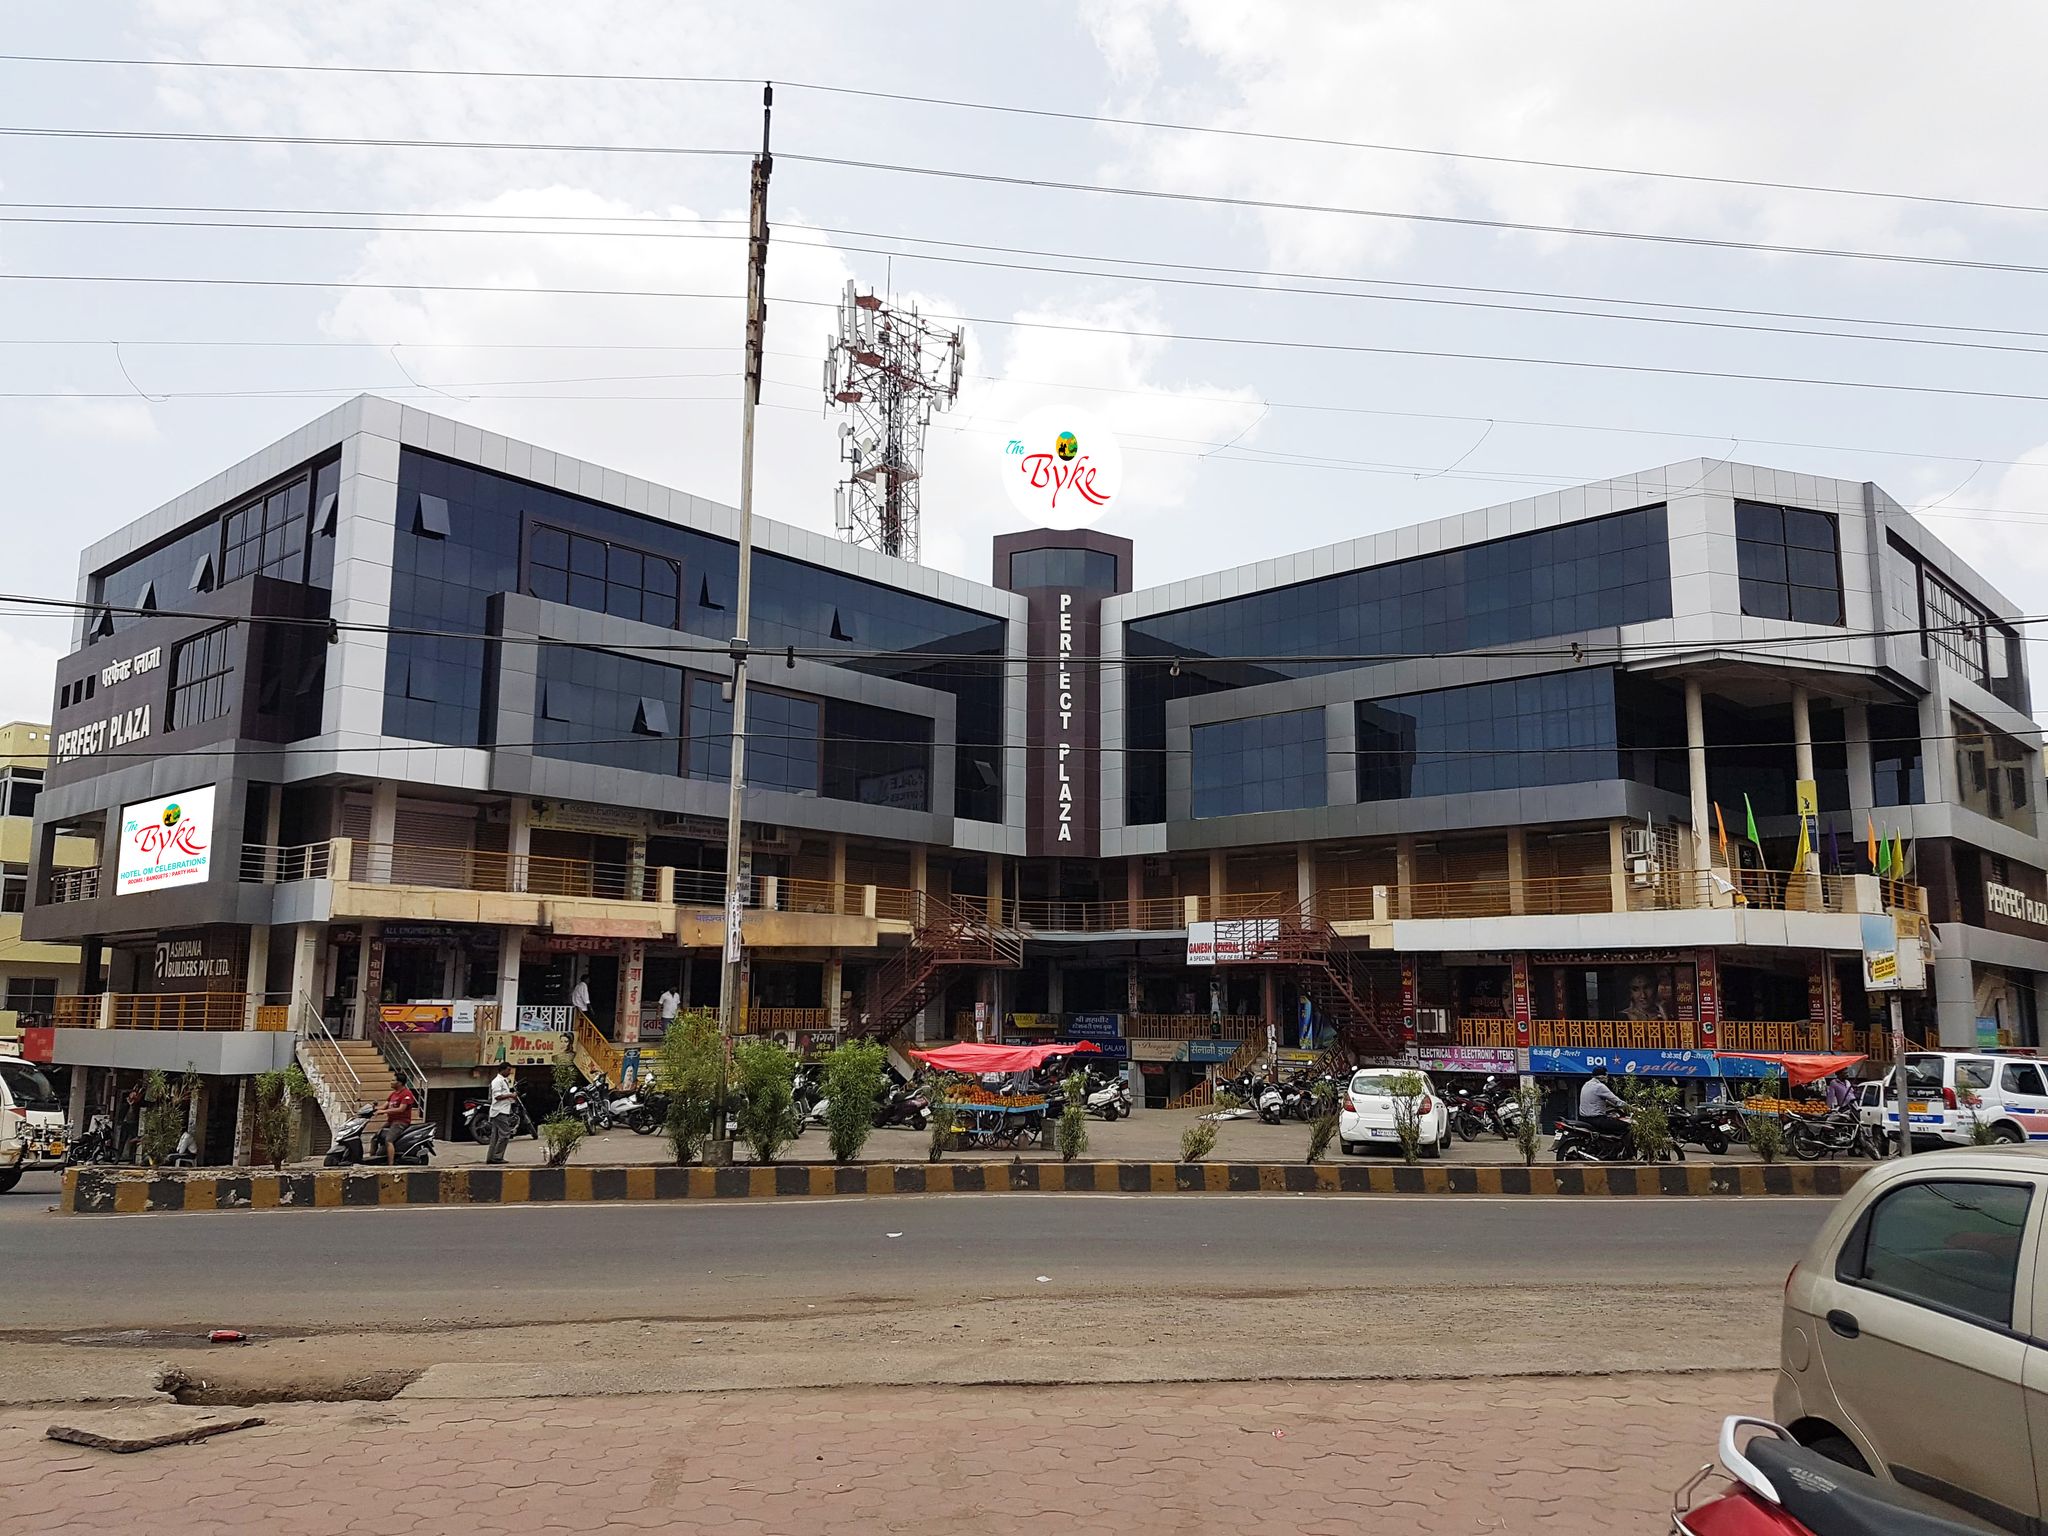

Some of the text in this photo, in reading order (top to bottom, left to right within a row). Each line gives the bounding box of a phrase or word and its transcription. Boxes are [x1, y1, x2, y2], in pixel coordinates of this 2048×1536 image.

[1005, 440, 1111, 508] The Byke
[1057, 594, 1072, 841] PERFECT PLAZA
[57, 704, 150, 764] PERFECT PLAZA
[124, 818, 207, 865] The Byke
[120, 857, 207, 880] HOTEL OM CELEBRATIONS
[1986, 881, 2026, 920] PERFECT
[169, 940, 202, 958] ASHIYANA
[1189, 942, 1212, 954] GANESH
[168, 960, 198, 977] BUILDERS
[215, 959, 230, 976] LTD.
[1104, 1044, 1126, 1052] GALAXY
[1420, 1048, 1451, 1059] ELECTRICAL
[1454, 1049, 1459, 1059] &
[1461, 1049, 1495, 1060] ELECTRONIC
[1497, 1049, 1514, 1060] ITEMS
[1586, 1056, 1607, 1067] BOI
